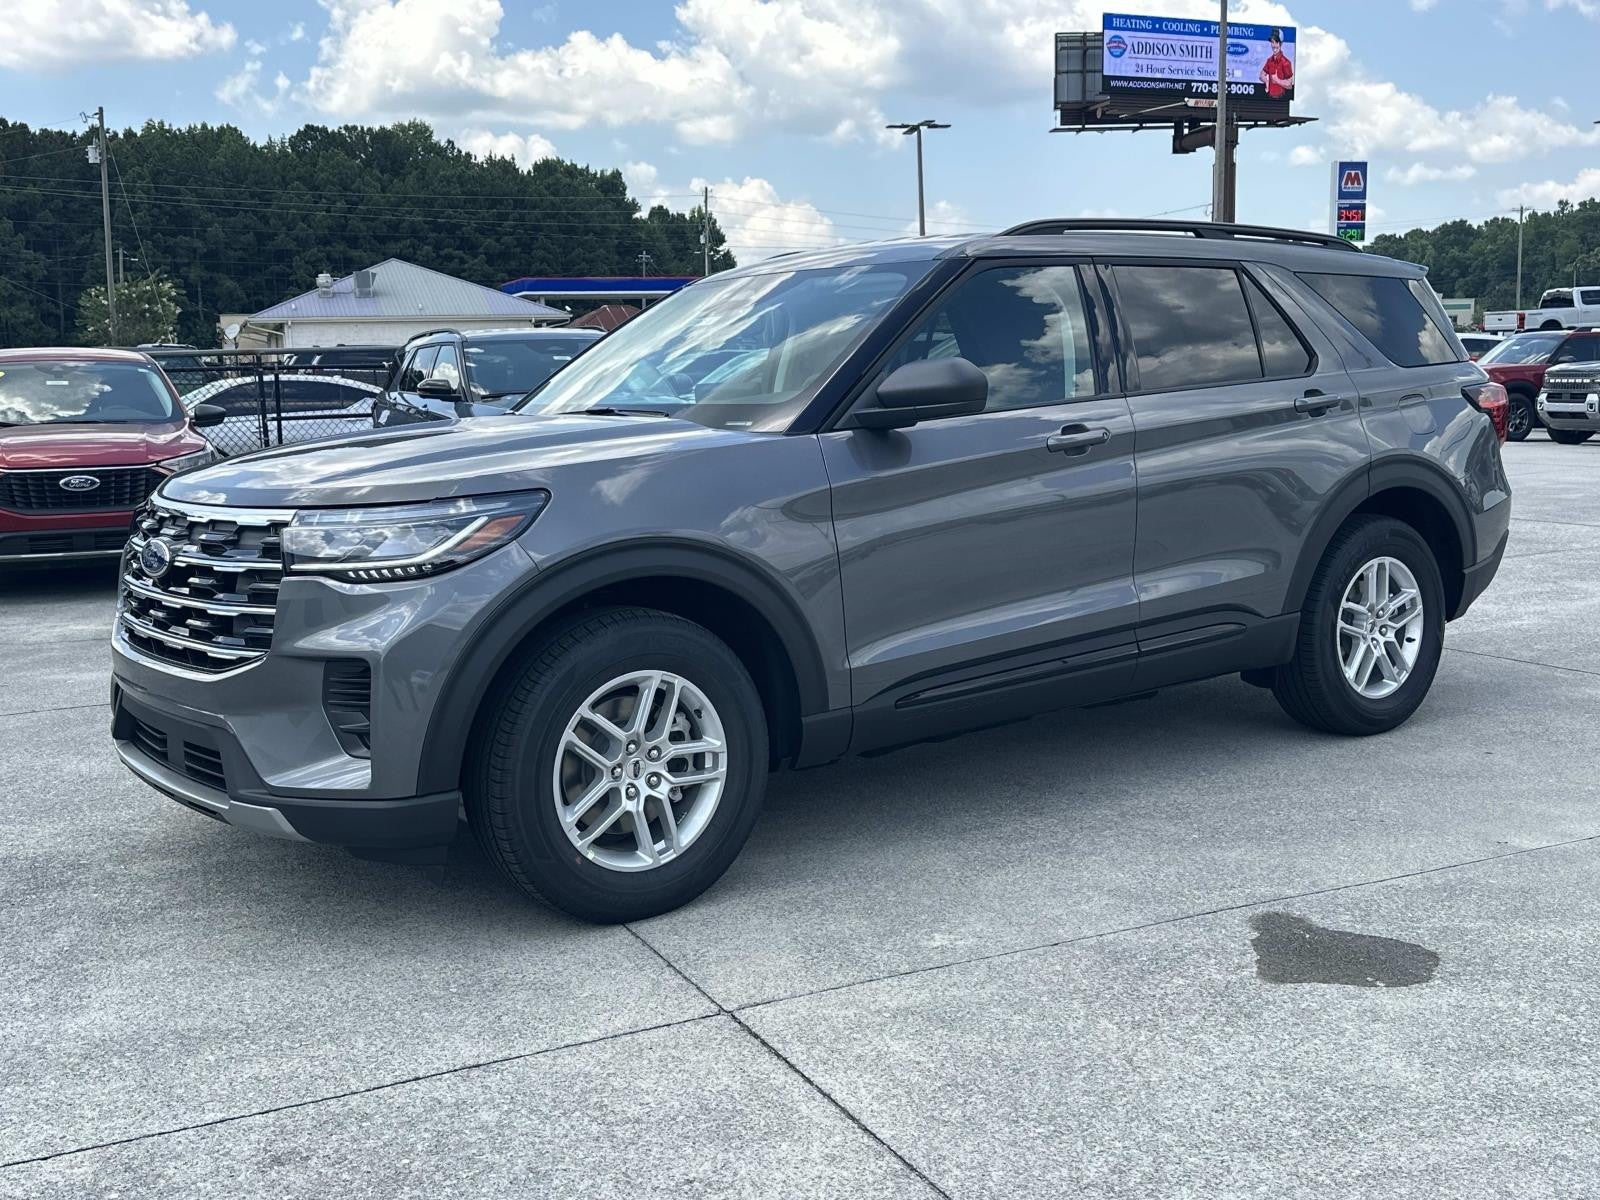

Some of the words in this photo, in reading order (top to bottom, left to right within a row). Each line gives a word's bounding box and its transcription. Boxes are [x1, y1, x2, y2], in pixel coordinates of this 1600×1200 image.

[1112, 17, 1152, 30] HEATING
[1162, 21, 1201, 33] COOLING
[1210, 25, 1255, 37] PLMBING
[1129, 41, 1177, 57] ADDISON
[1179, 44, 1213, 59] SMITH
[1146, 64, 1166, 74] Hour
[1167, 65, 1196, 76] Service
[1197, 66, 1217, 77] Since
[1110, 79, 1187, 90] WWW.ADDISONSMITH.NET
[1191, 82, 1255, 95] 770-8-9006
